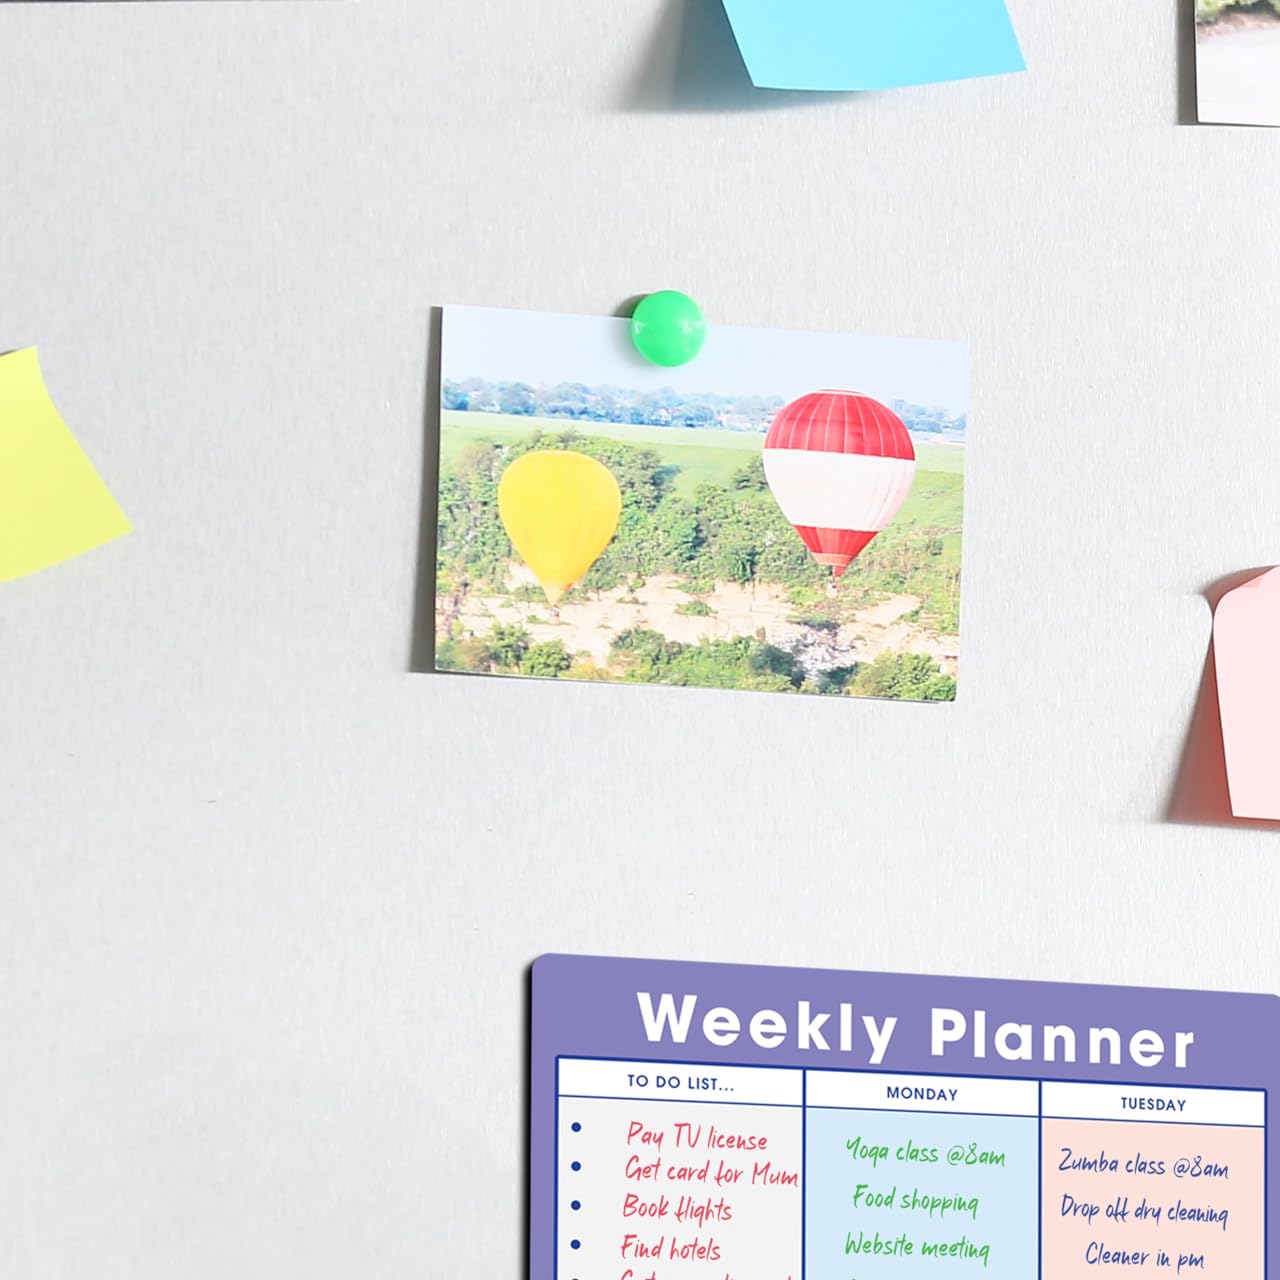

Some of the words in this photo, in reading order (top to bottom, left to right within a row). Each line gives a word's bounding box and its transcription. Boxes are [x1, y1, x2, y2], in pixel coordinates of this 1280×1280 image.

[636, 991, 899, 1064] Weekly
[930, 1007, 1196, 1069] Planner
[627, 1074, 649, 1088] TO
[656, 1075, 681, 1089] DO
[688, 1077, 735, 1092] LIST...
[886, 1086, 958, 1101] MONDAY
[1121, 1096, 1187, 1112] TUESDAY
[626, 1120, 664, 1155] Pay
[674, 1122, 702, 1148] TV
[707, 1125, 768, 1151] license
[845, 1135, 889, 1169] Yoga
[895, 1139, 939, 1163] class
[947, 1142, 1006, 1168] @8am
[625, 1154, 661, 1181] Get
[667, 1159, 711, 1182] card
[713, 1159, 745, 1187] for
[751, 1161, 799, 1188] Mum
[1058, 1147, 1119, 1173] Zumba
[1125, 1152, 1166, 1176] class
[1172, 1155, 1229, 1180] @8am
[623, 1193, 670, 1219] Book
[674, 1195, 733, 1229] flights
[852, 1183, 897, 1209] Food
[900, 1187, 979, 1221] shopping
[1060, 1193, 1100, 1225] Drop
[1105, 1196, 1130, 1223] off
[1134, 1199, 1162, 1227] dry
[1167, 1199, 1229, 1232] cleaning
[620, 1233, 665, 1260] Find
[669, 1236, 722, 1262] hotels
[844, 1231, 914, 1256] Website
[921, 1235, 991, 1268] meeting
[1085, 1241, 1150, 1265] Cleaner
[1156, 1248, 1171, 1267] in
[1176, 1254, 1205, 1275] pm
